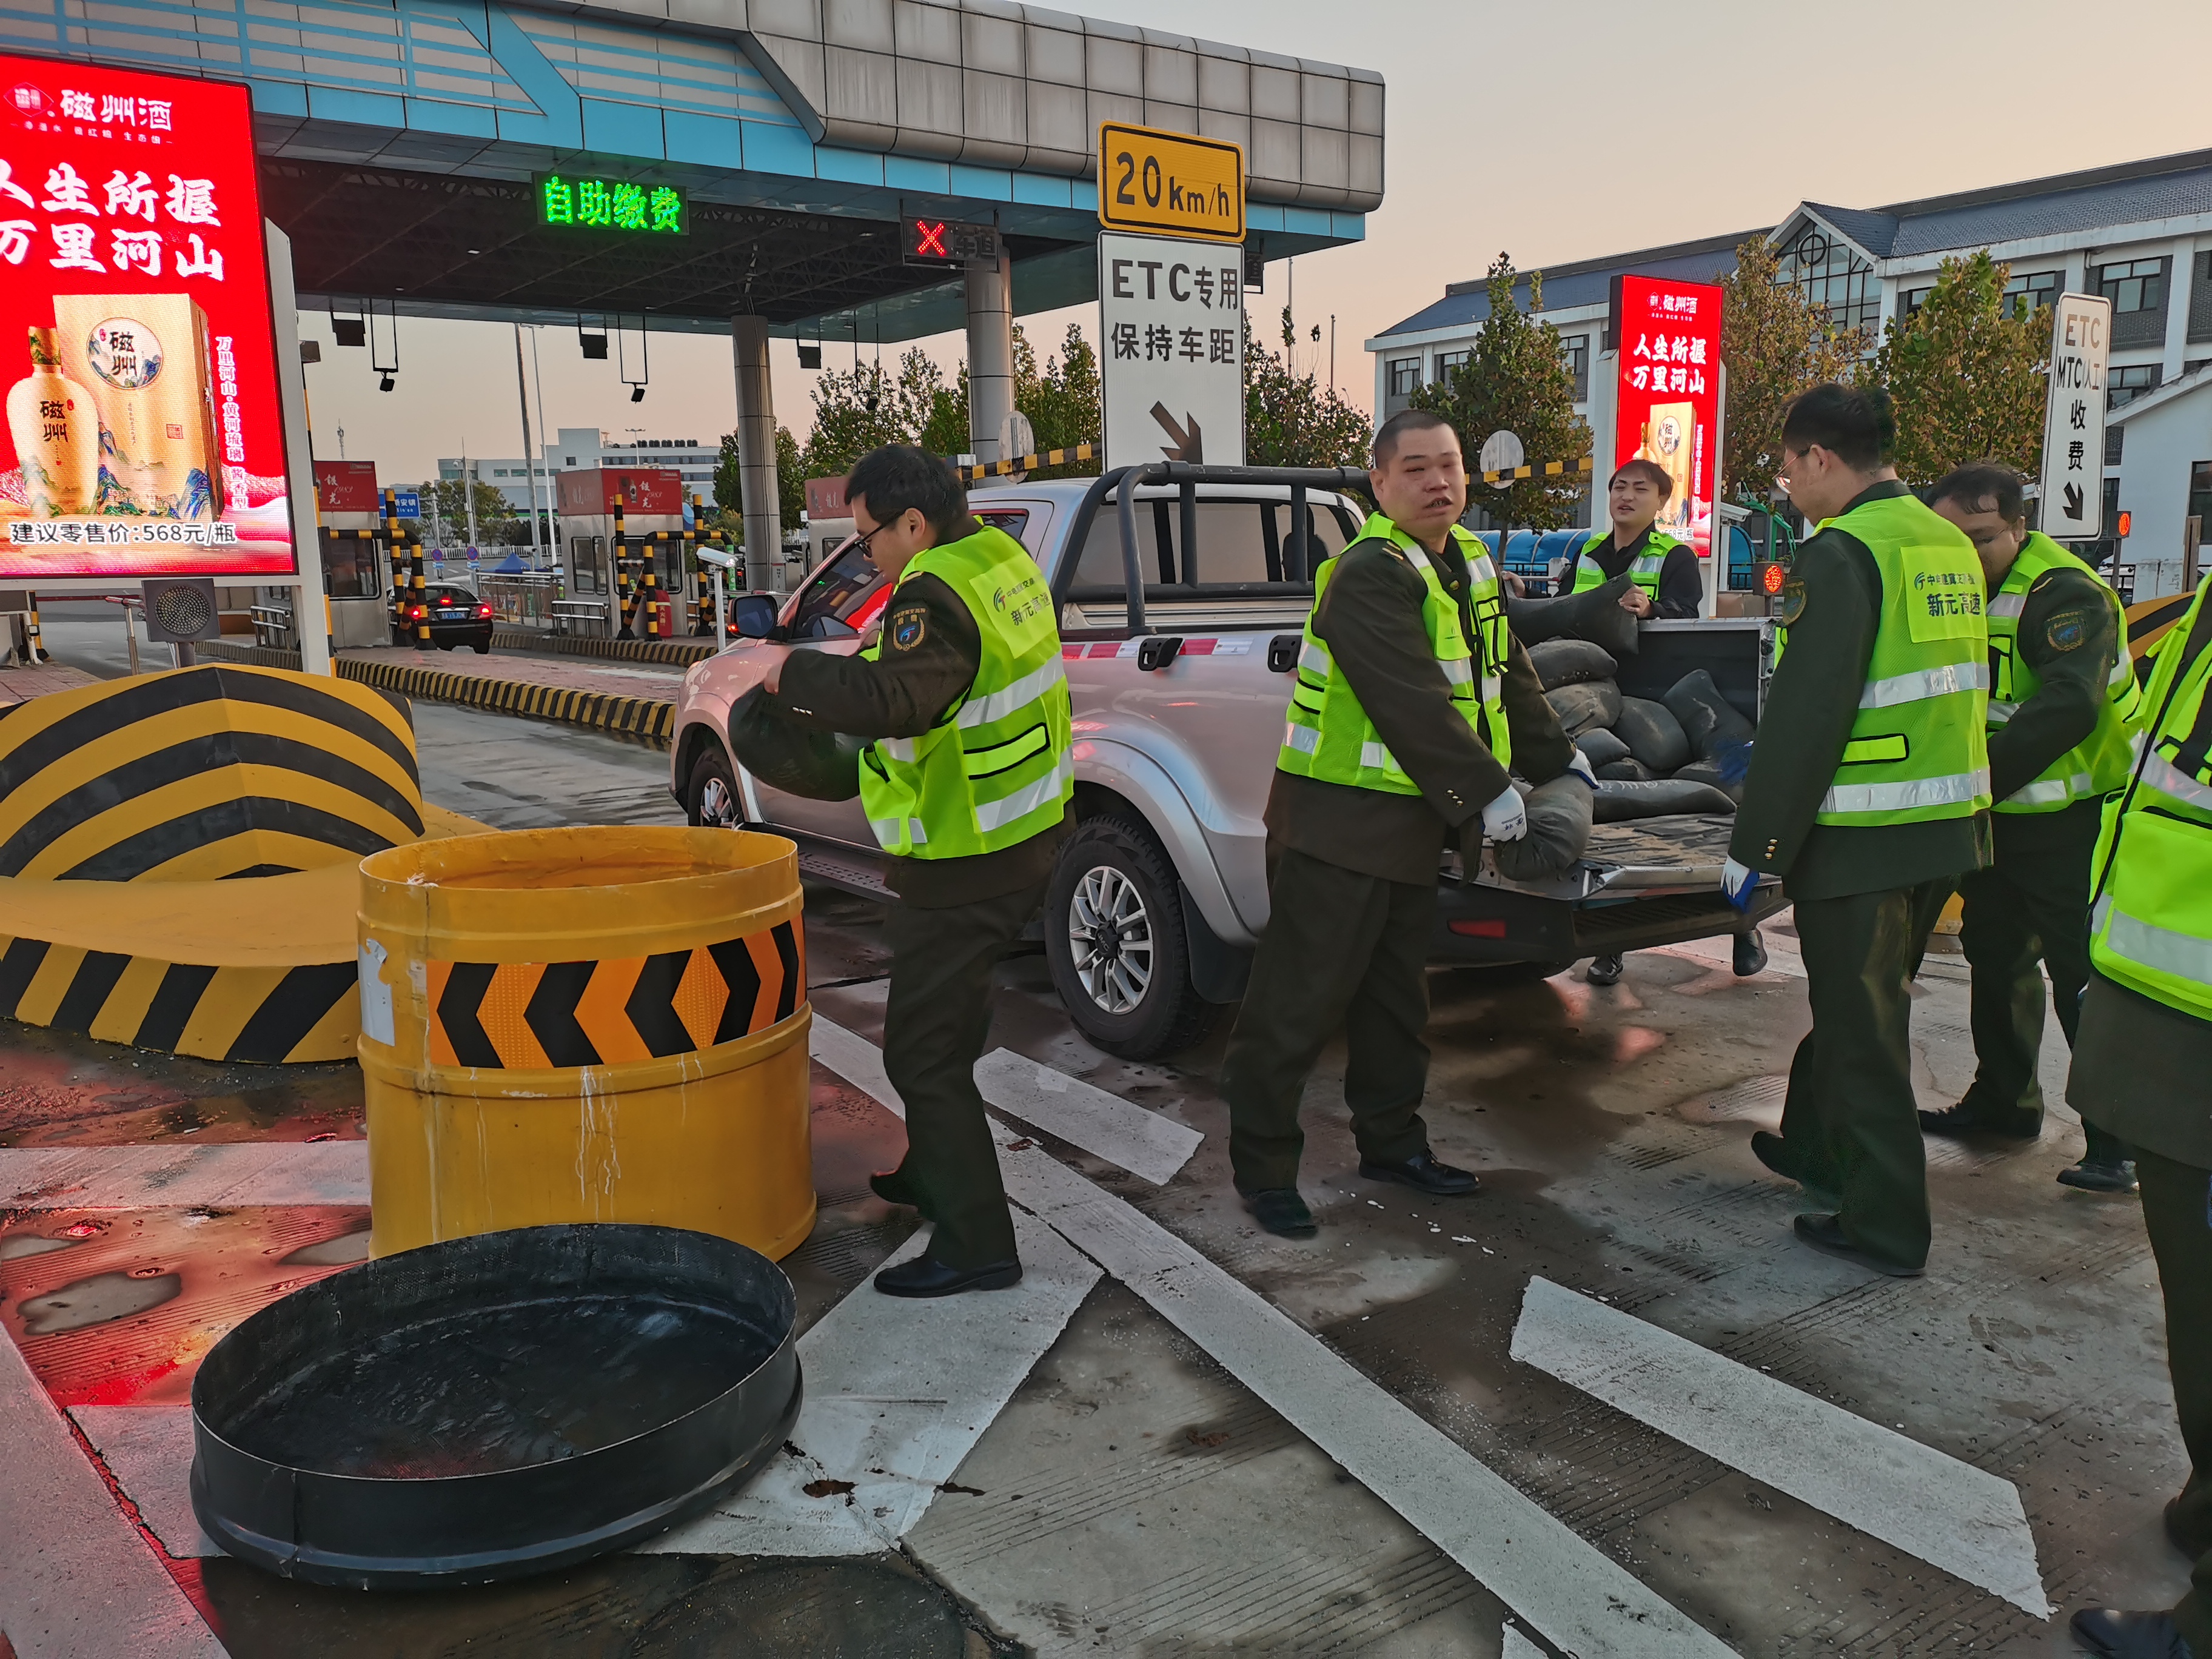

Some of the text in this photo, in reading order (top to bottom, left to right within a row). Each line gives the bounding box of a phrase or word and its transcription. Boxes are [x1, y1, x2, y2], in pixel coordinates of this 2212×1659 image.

[60, 90, 172, 132] 磁州酒
[545, 176, 680, 233] 自助缴费
[0, 219, 224, 281] 万里河山
[1112, 260, 1238, 310] ETC专用
[1663, 295, 1698, 314] 磁州酒
[1111, 322, 1235, 364] 保持车距
[1633, 333, 1706, 365] 人生所握
[2065, 313, 2100, 349] ETC
[1633, 366, 1705, 395] 万里河山
[2068, 399, 2085, 471] 收费
[1010, 592, 1051, 626] 新元高速
[1926, 591, 1980, 617] 新元高速
